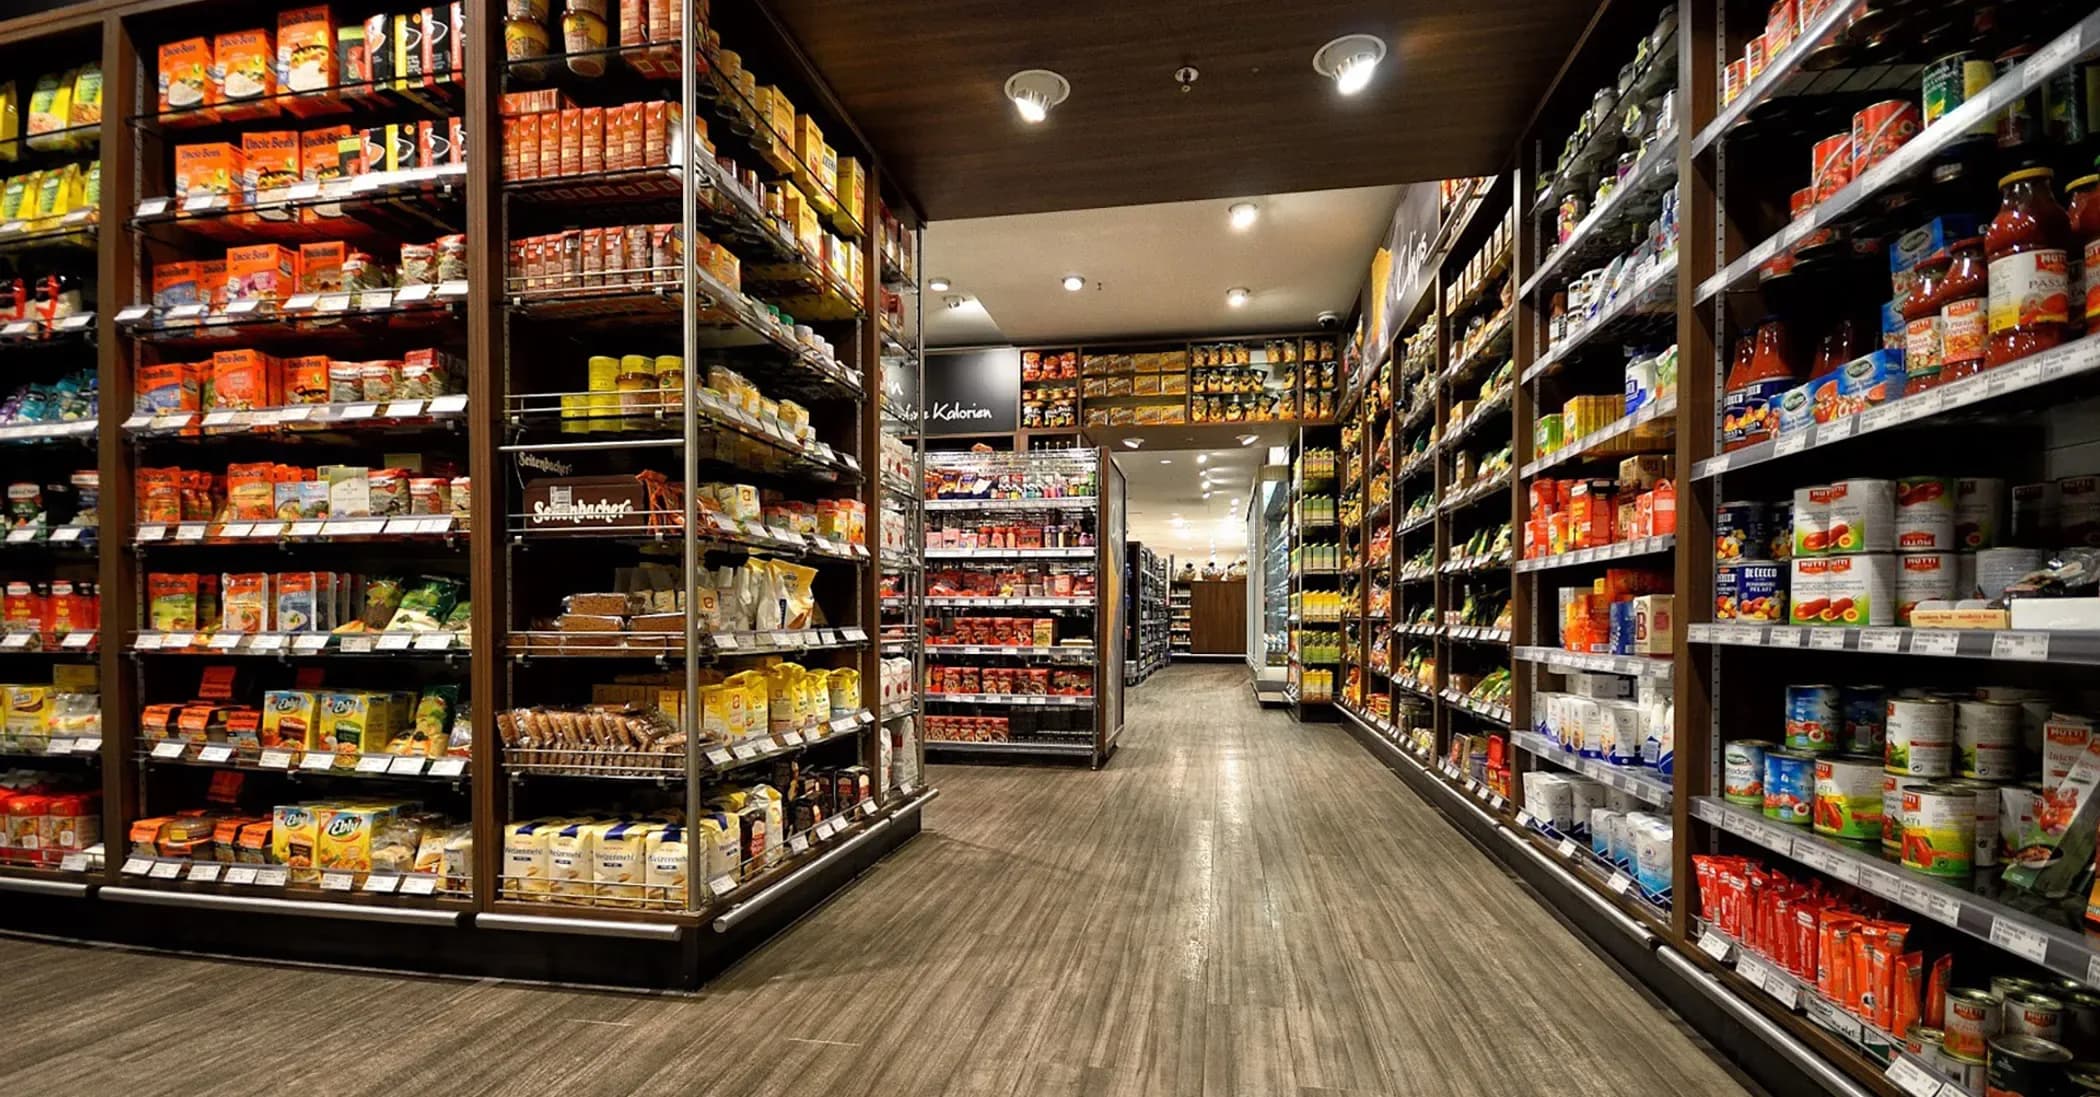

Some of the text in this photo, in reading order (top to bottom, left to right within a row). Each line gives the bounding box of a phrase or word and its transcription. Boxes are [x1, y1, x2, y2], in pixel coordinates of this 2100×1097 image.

[932, 401, 993, 422] Kalorien
[518, 451, 569, 475] Seitenbacher
[329, 815, 362, 837] Ebly
